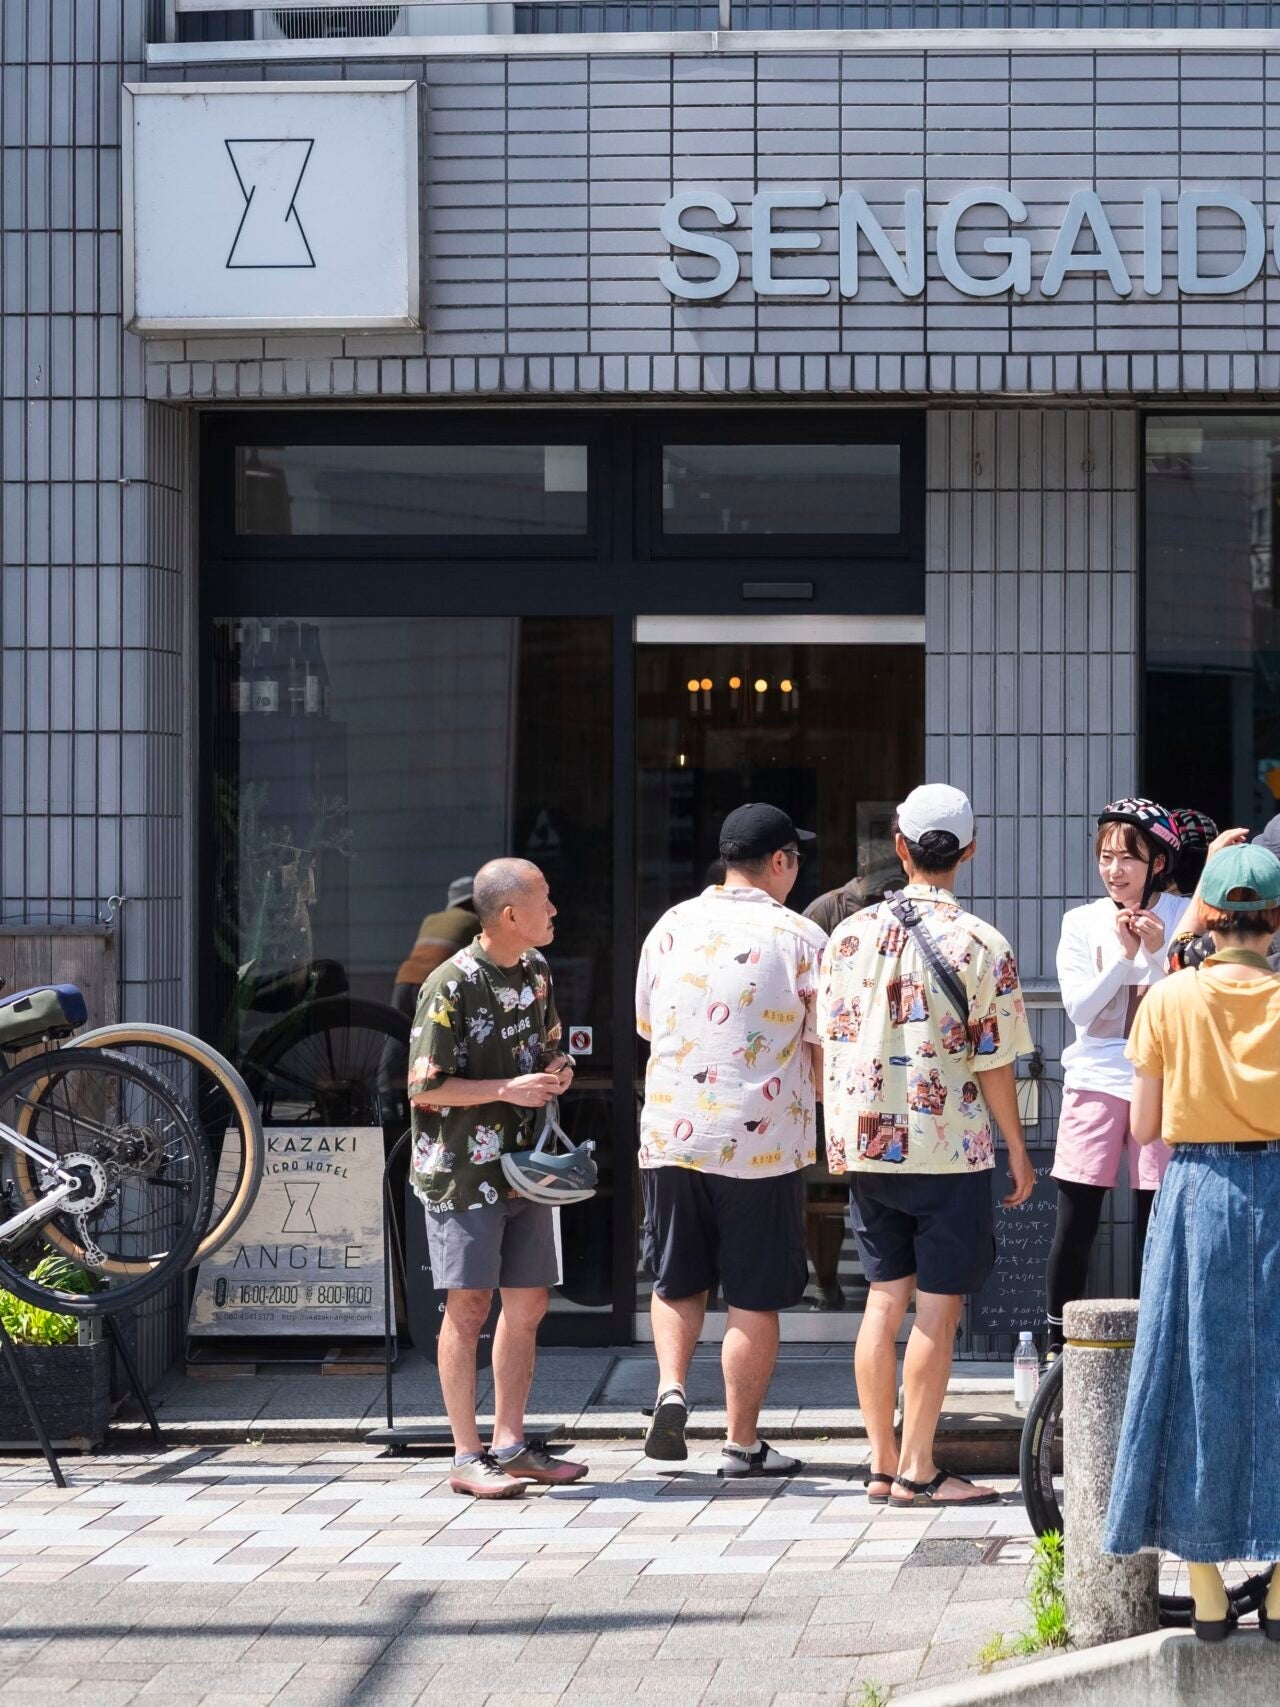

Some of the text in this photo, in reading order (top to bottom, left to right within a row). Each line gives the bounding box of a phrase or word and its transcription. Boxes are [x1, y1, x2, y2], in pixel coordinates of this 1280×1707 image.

[267, 1137, 357, 1153] KAZAKI
[263, 1161, 348, 1179] ICRO HOTEL
[233, 1245, 364, 1269] ANGLE
